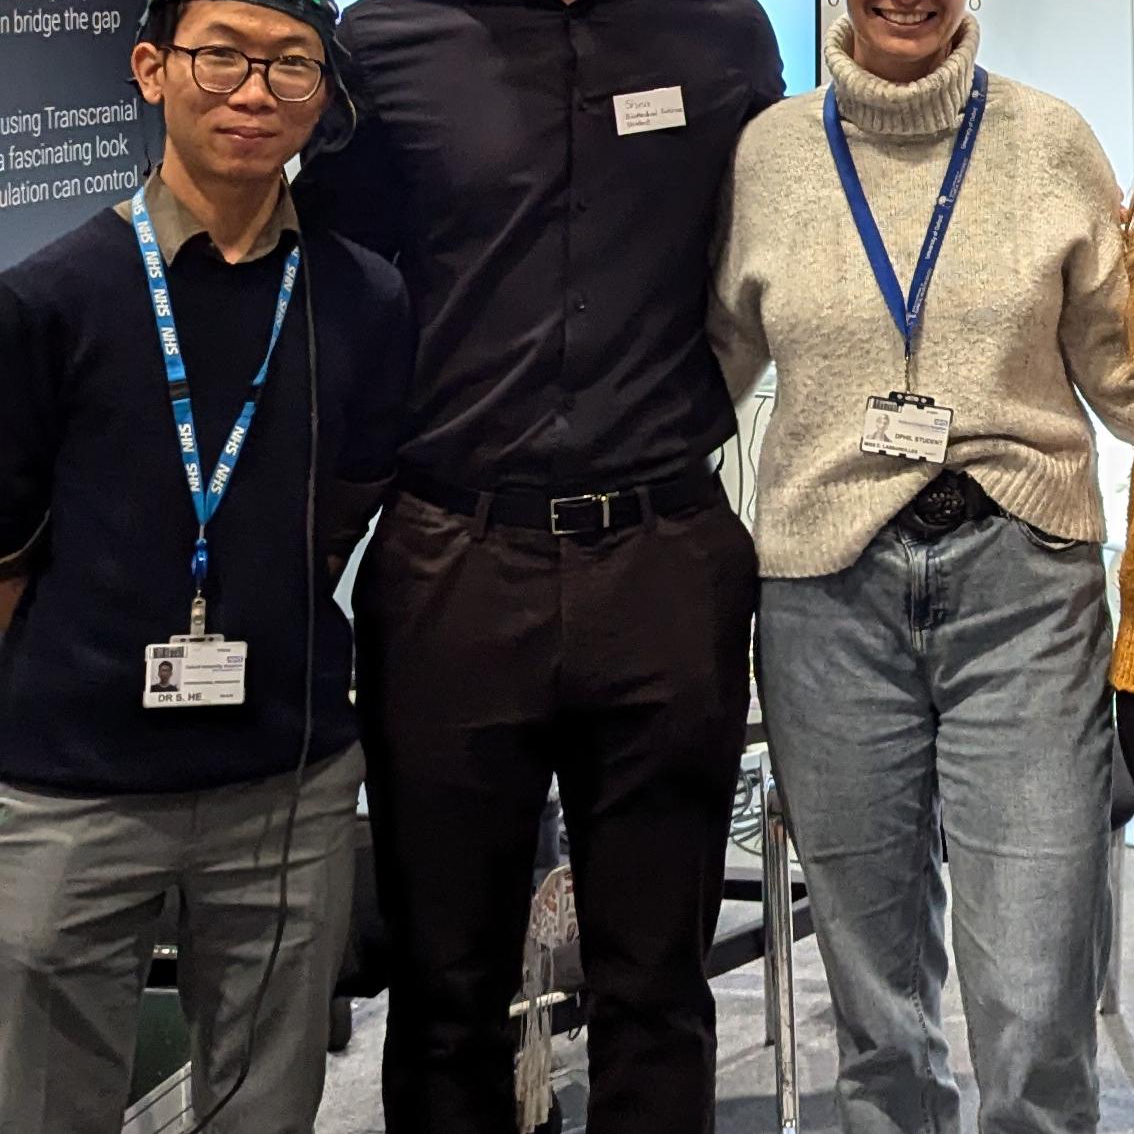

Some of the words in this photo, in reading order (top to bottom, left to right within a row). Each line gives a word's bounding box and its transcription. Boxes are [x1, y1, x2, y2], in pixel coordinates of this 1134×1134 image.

[13, 8, 61, 37] bridge
[64, 8, 88, 32] the
[92, 10, 121, 35] gap
[2, 109, 42, 137] using
[44, 98, 137, 130] Transcranial
[9, 140, 92, 170] fascinating
[96, 132, 129, 158] look
[0, 182, 49, 208] ulation
[52, 178, 80, 200] can
[84, 165, 138, 195] control
[137, 221, 154, 244] NHS
[145, 251, 163, 279] NHS
[153, 288, 171, 317] NHS
[161, 326, 179, 356] NHS
[178, 423, 195, 453] NHS
[225, 426, 245, 456] NHS
[914, 436, 943, 446] STUDENT
[186, 463, 201, 492] NHS
[211, 463, 231, 494] NHS
[158, 693, 173, 703] DR
[176, 693, 186, 702] S.
[188, 692, 203, 702] HE
